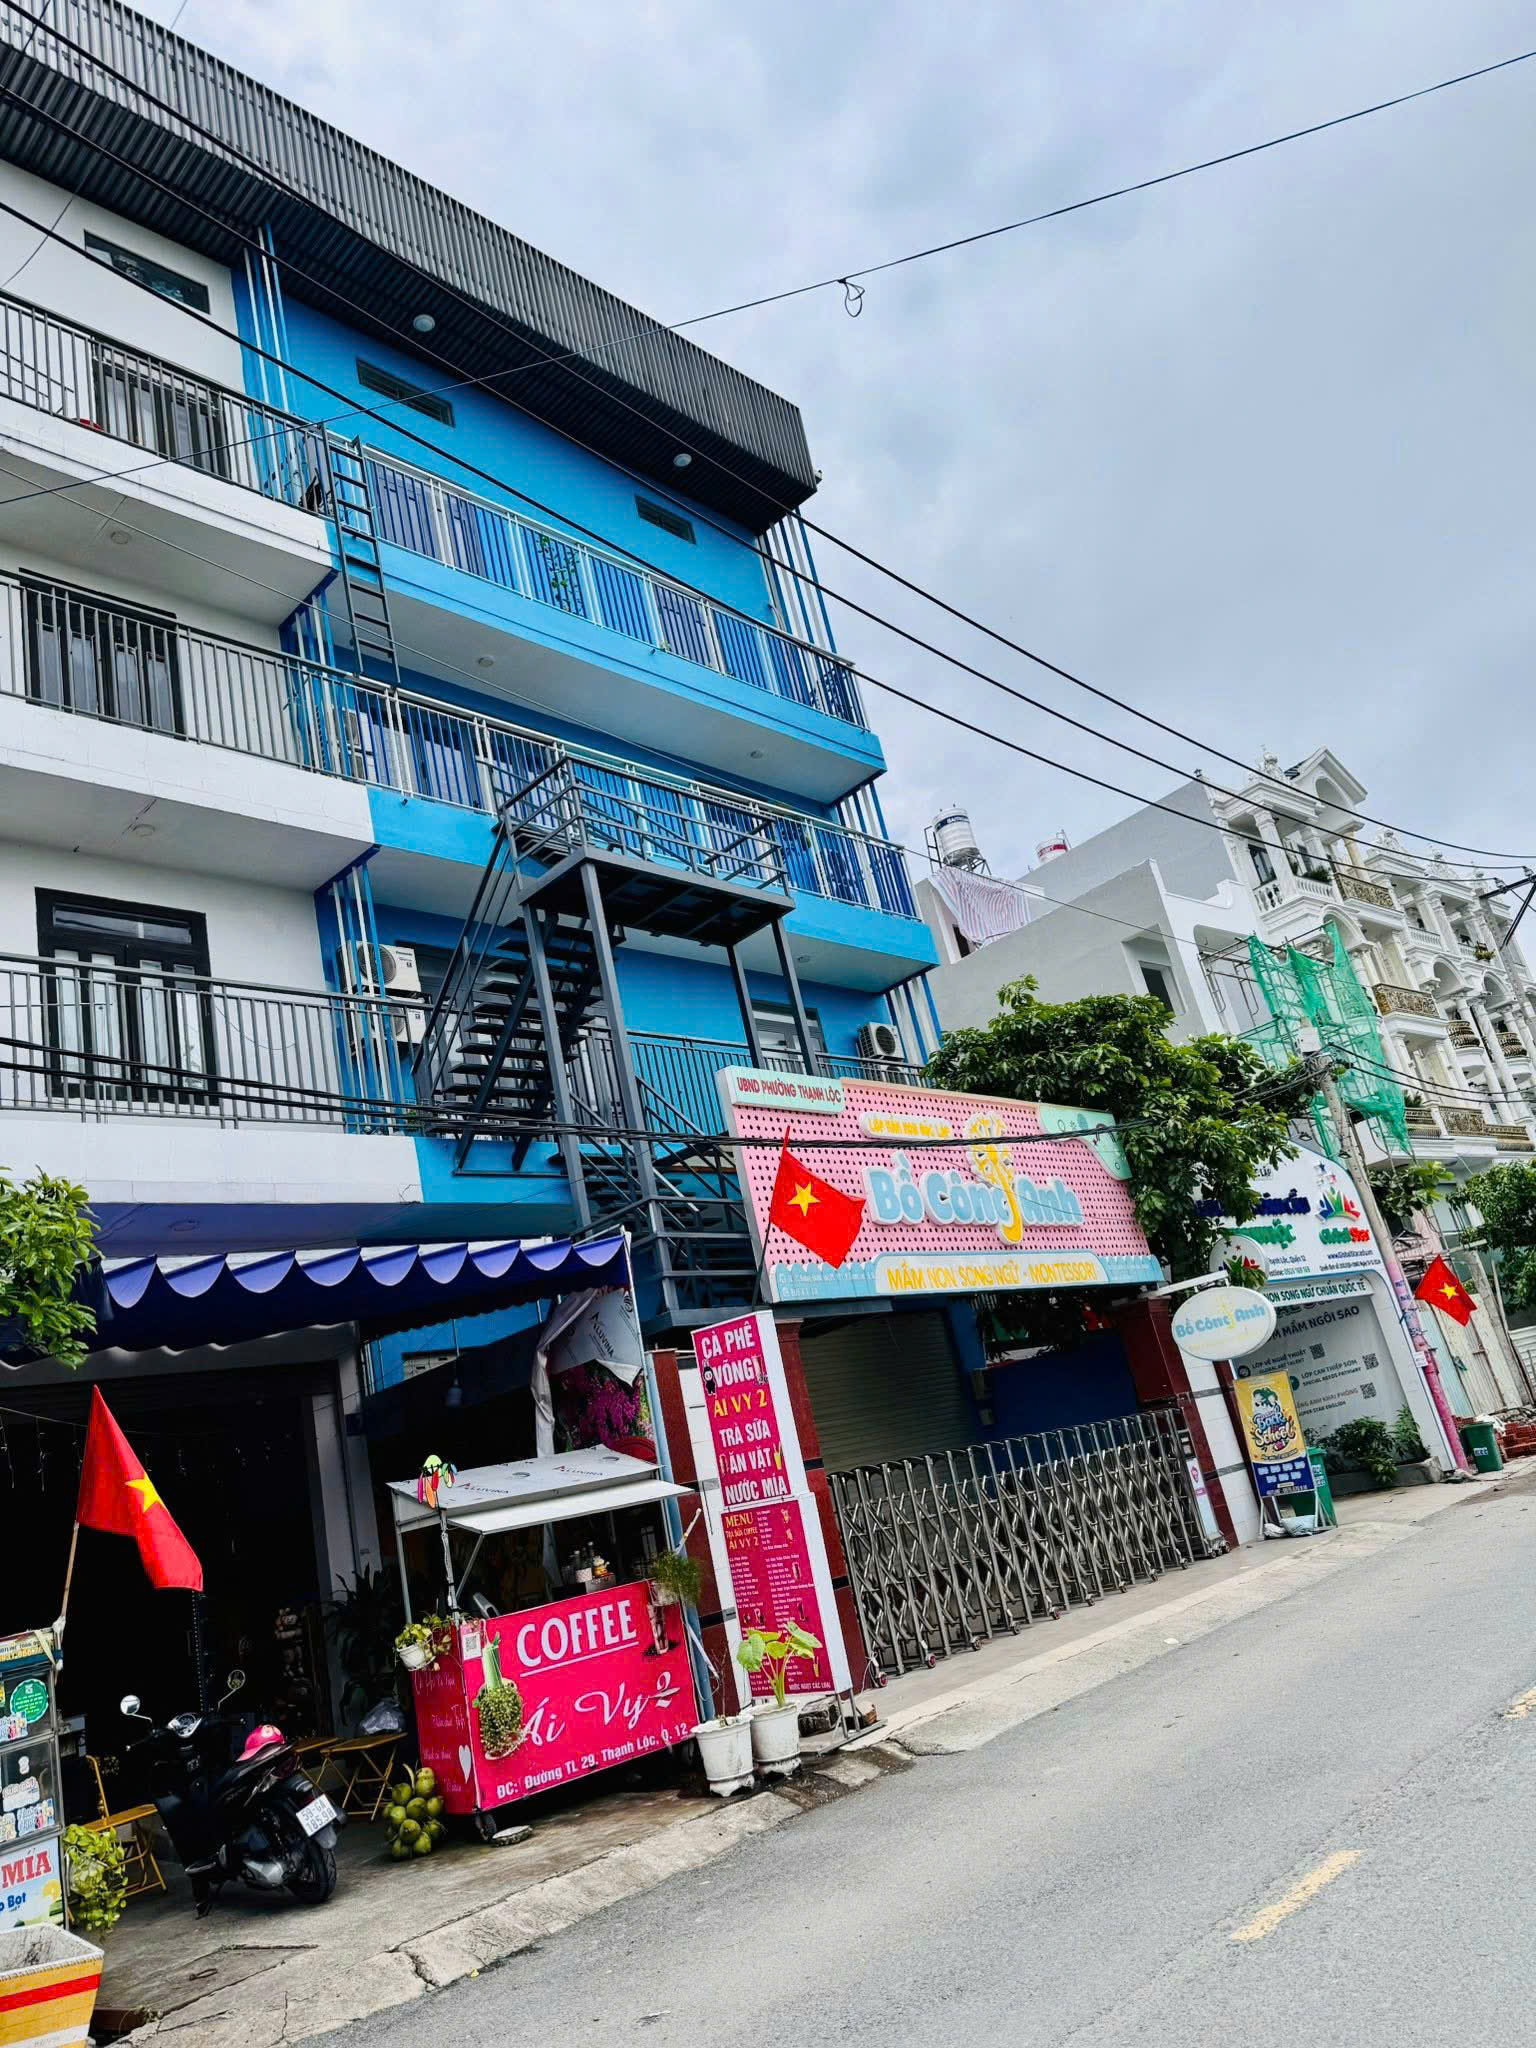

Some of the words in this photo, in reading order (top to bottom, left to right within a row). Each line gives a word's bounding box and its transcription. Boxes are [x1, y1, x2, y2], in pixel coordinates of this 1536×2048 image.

[737, 1077, 760, 1094] UBND
[761, 1078, 797, 1097] PHƯỜNG
[798, 1084, 824, 1103] THẠNH
[825, 1086, 842, 1106] LỘC
[866, 1151, 923, 1222] Bồ
[1016, 1177, 1083, 1224] Anh
[887, 1260, 926, 1291] MẦM
[927, 1267, 957, 1289] NON
[959, 1264, 994, 1286] SONG
[994, 1260, 1020, 1285] NGỮ
[1029, 1260, 1098, 1284] MONTESSORI
[1280, 1289, 1301, 1302] SONG
[1316, 1280, 1339, 1298] CHUẨN
[1339, 1279, 1357, 1295] QUỐC
[1175, 1317, 1194, 1338] Bồ
[1234, 1303, 1265, 1322] Anh
[1282, 1320, 1308, 1337] MẦM
[1309, 1312, 1336, 1329] NGÔI
[1337, 1306, 1360, 1321] SAO
[701, 1329, 724, 1359] CÀ
[724, 1320, 756, 1353] PHÊ
[713, 1357, 756, 1388] VÕNG
[730, 1391, 752, 1413] VY
[756, 1389, 768, 1408] 2
[719, 1422, 744, 1448] TRÀ
[745, 1417, 771, 1442] SỮA
[729, 1450, 748, 1474] ĂN
[725, 1477, 760, 1505] NƯỚC
[761, 1472, 788, 1498] MÍA
[725, 1511, 753, 1528] MENU
[516, 1599, 637, 1668] COFFEE
[522, 1697, 566, 1746] Ái
[574, 1682, 650, 1730] Vy
[651, 1671, 681, 1709] 2
[496, 1781, 518, 1798] ĐC:
[524, 1766, 563, 1789] Đường
[565, 1759, 578, 1774] TL
[601, 1741, 635, 1763] Thạnh
[674, 1722, 689, 1737] 12
[2, 1848, 52, 1889] MÍA
